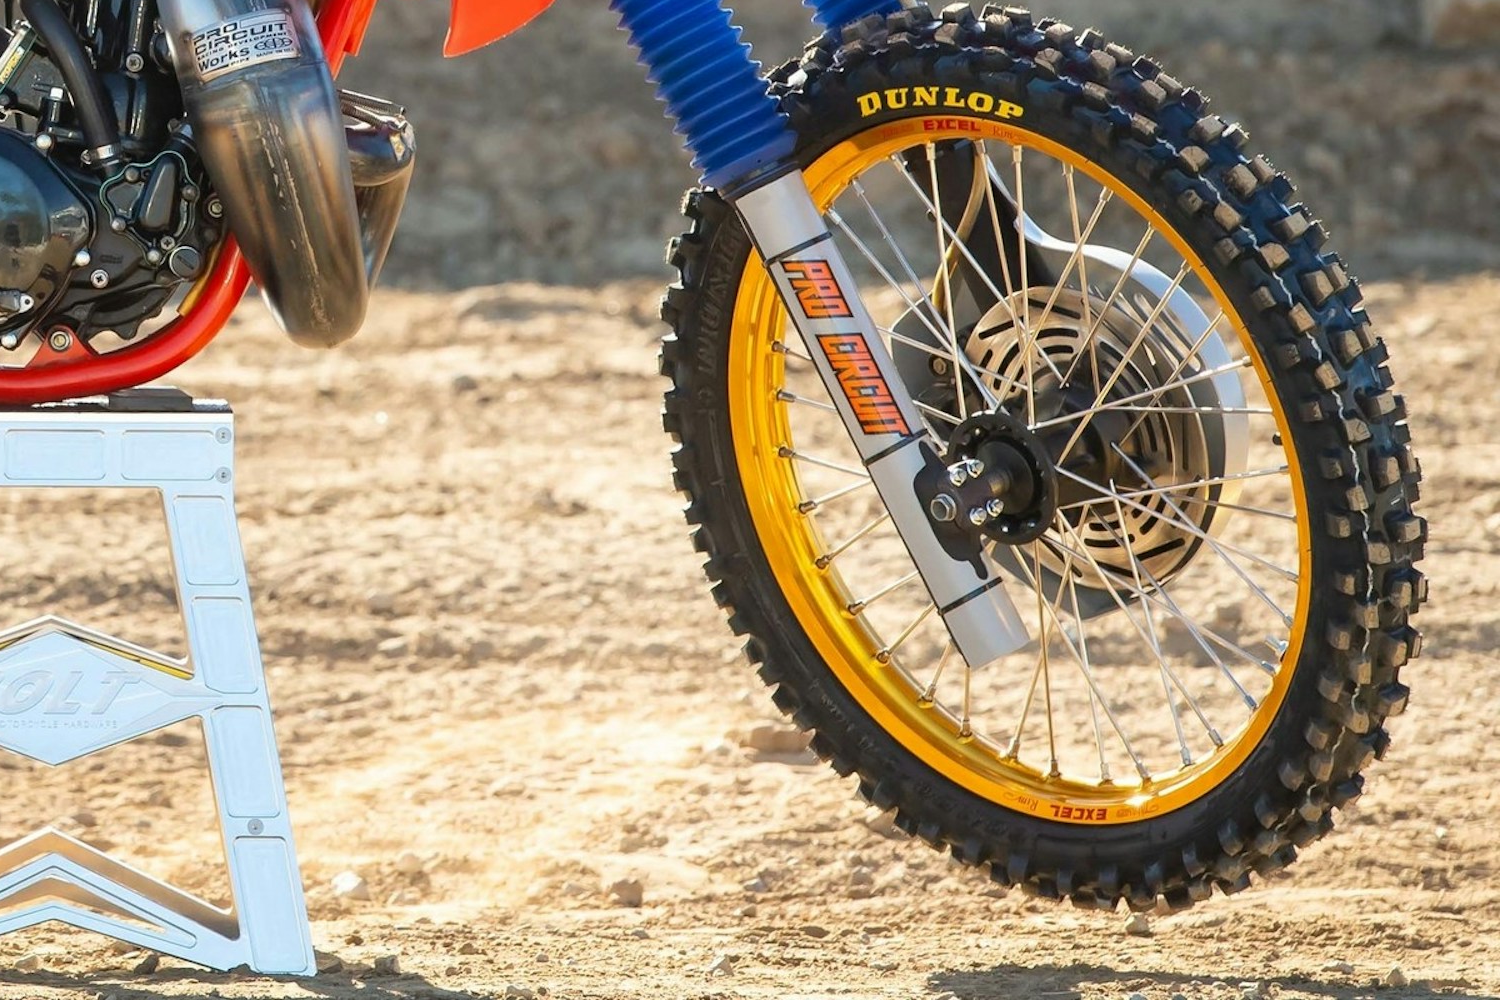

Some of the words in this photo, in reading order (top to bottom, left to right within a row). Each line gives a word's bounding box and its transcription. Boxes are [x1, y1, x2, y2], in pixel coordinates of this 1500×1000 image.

[193, 22, 238, 46] PRO
[195, 22, 287, 55] CIRCUIT
[199, 47, 250, 72] Works
[857, 86, 1024, 119] DUNLOP
[923, 119, 981, 132] EXCEL
[780, 260, 854, 319] PRO
[815, 333, 913, 436] CIRCUIT
[1050, 805, 1107, 820] EXCEL
